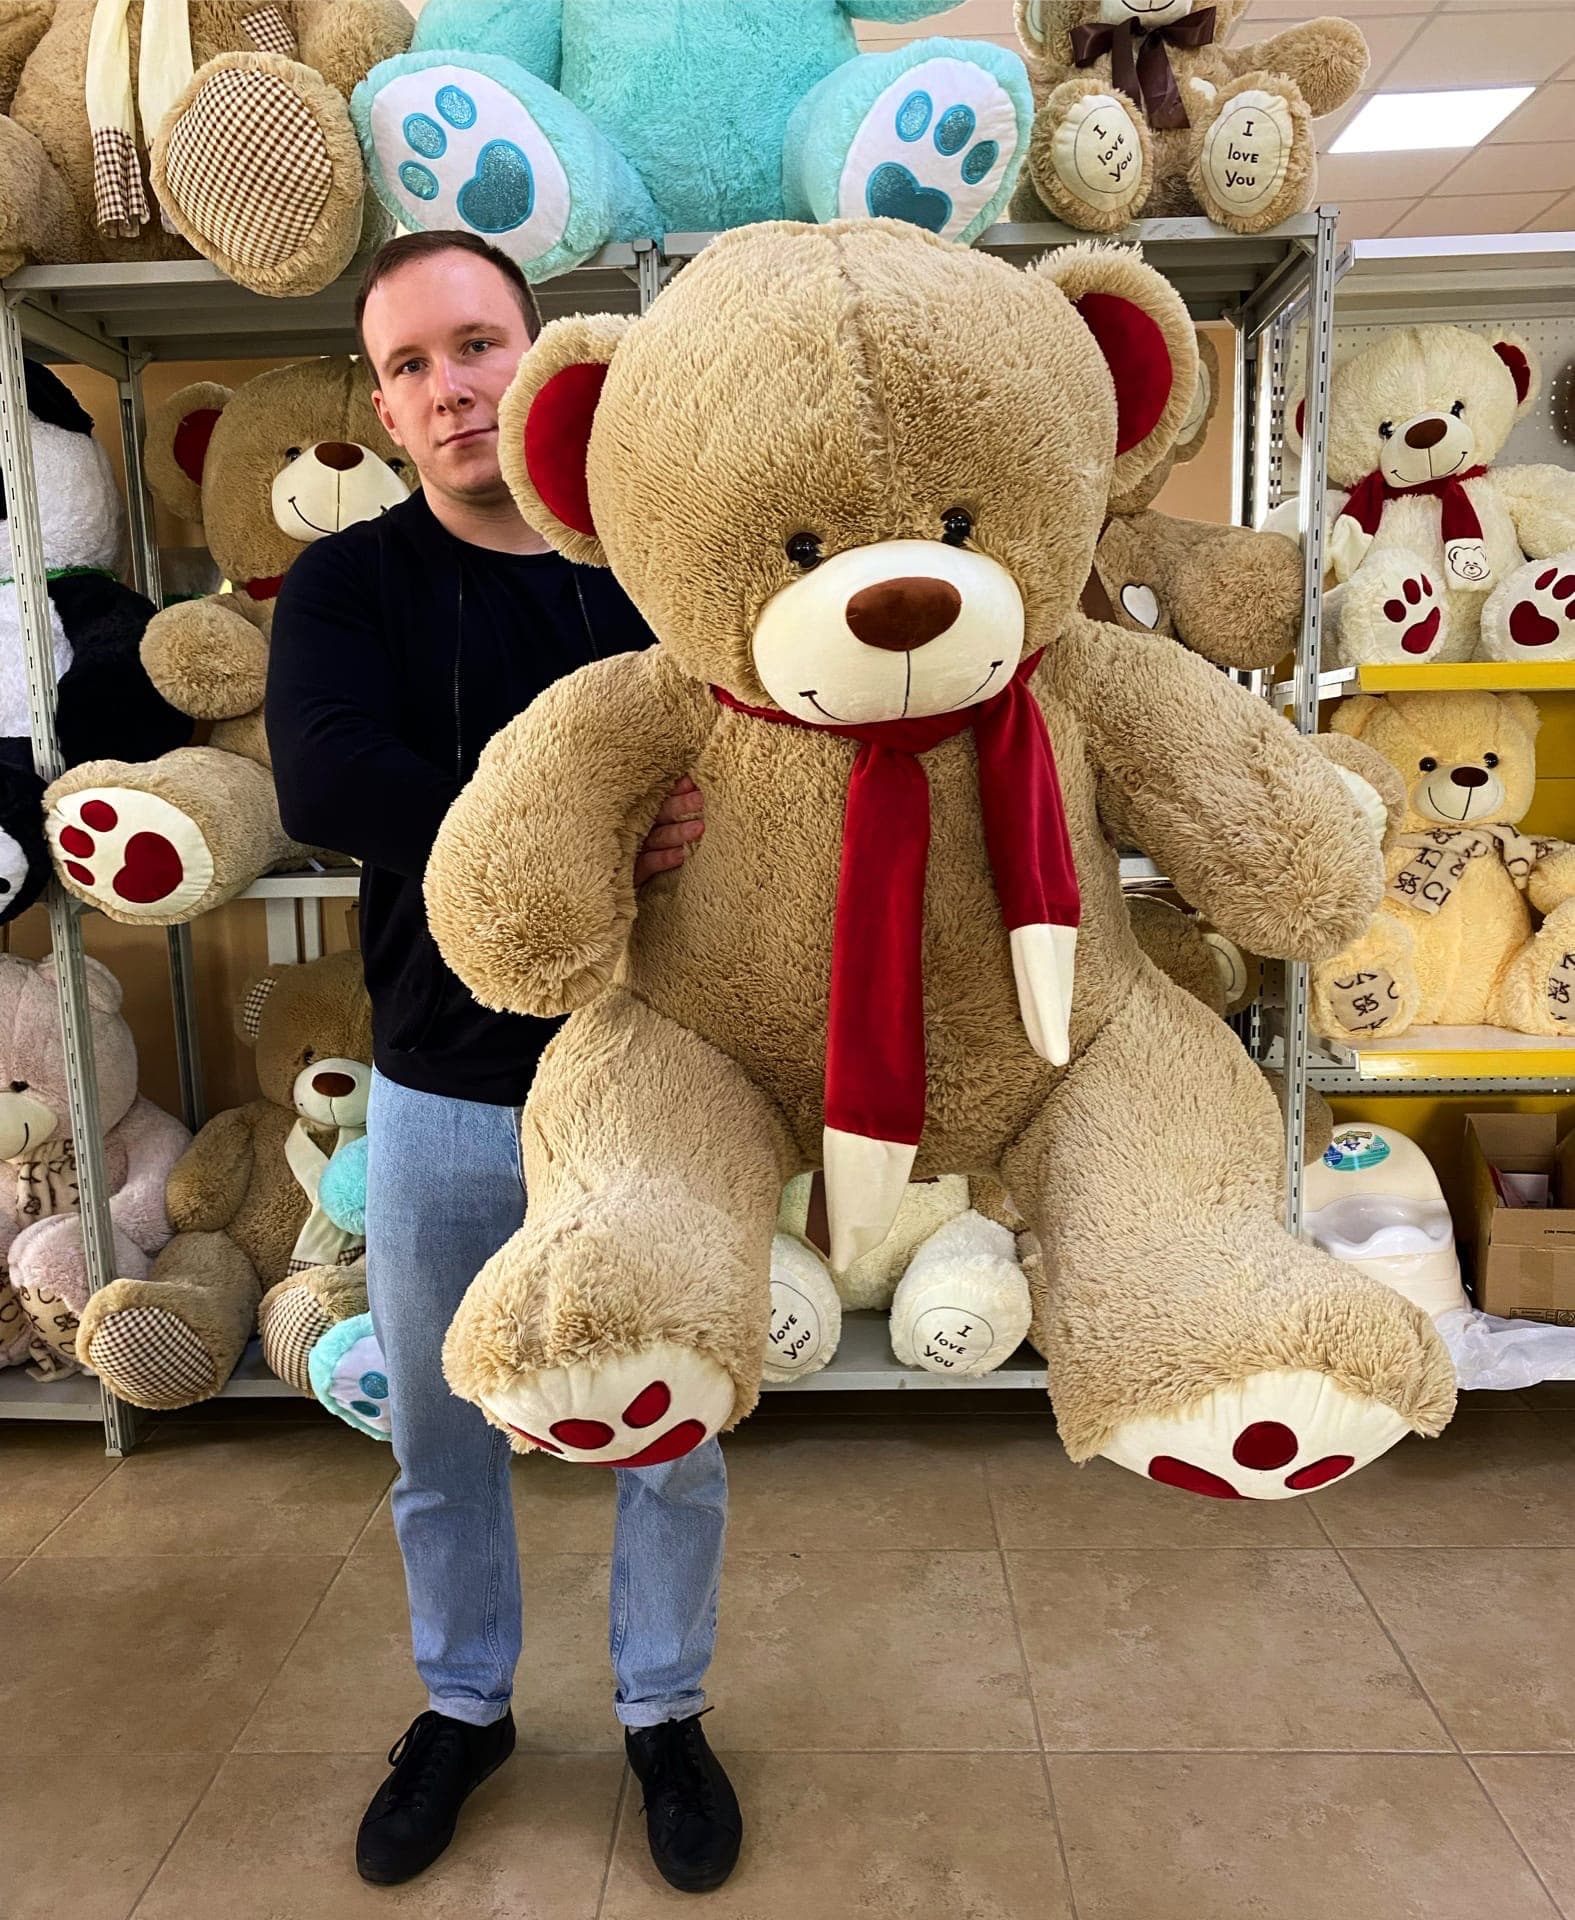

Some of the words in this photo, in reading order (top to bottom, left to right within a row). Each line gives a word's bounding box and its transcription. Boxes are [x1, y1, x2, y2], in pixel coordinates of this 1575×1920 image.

[1093, 124, 1107, 140] I
[1242, 120, 1254, 137] I
[956, 1325, 973, 1338] I
